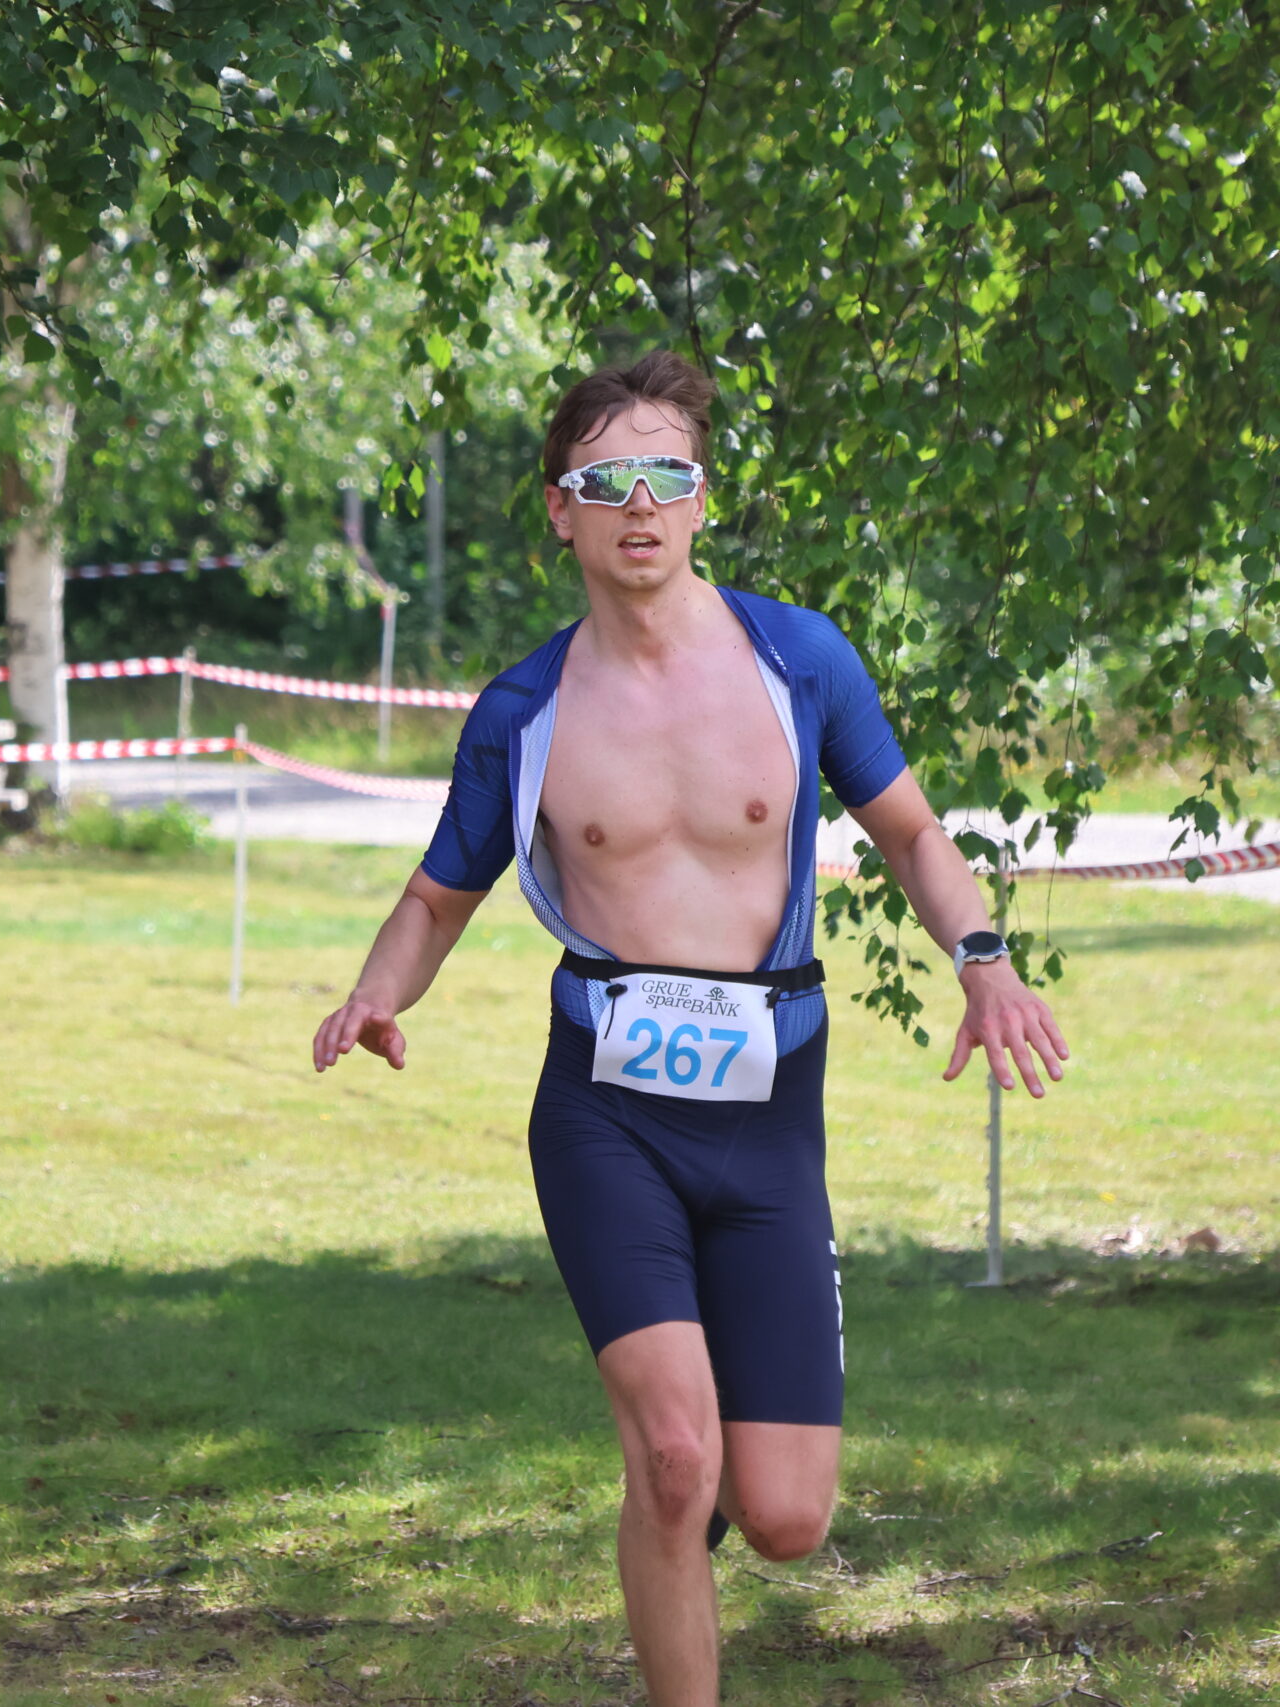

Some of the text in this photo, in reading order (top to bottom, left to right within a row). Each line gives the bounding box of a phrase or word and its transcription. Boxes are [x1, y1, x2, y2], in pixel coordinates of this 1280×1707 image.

[641, 979, 693, 998] GRUE
[645, 992, 741, 1017] spareBANK
[621, 1017, 749, 1088] 267
